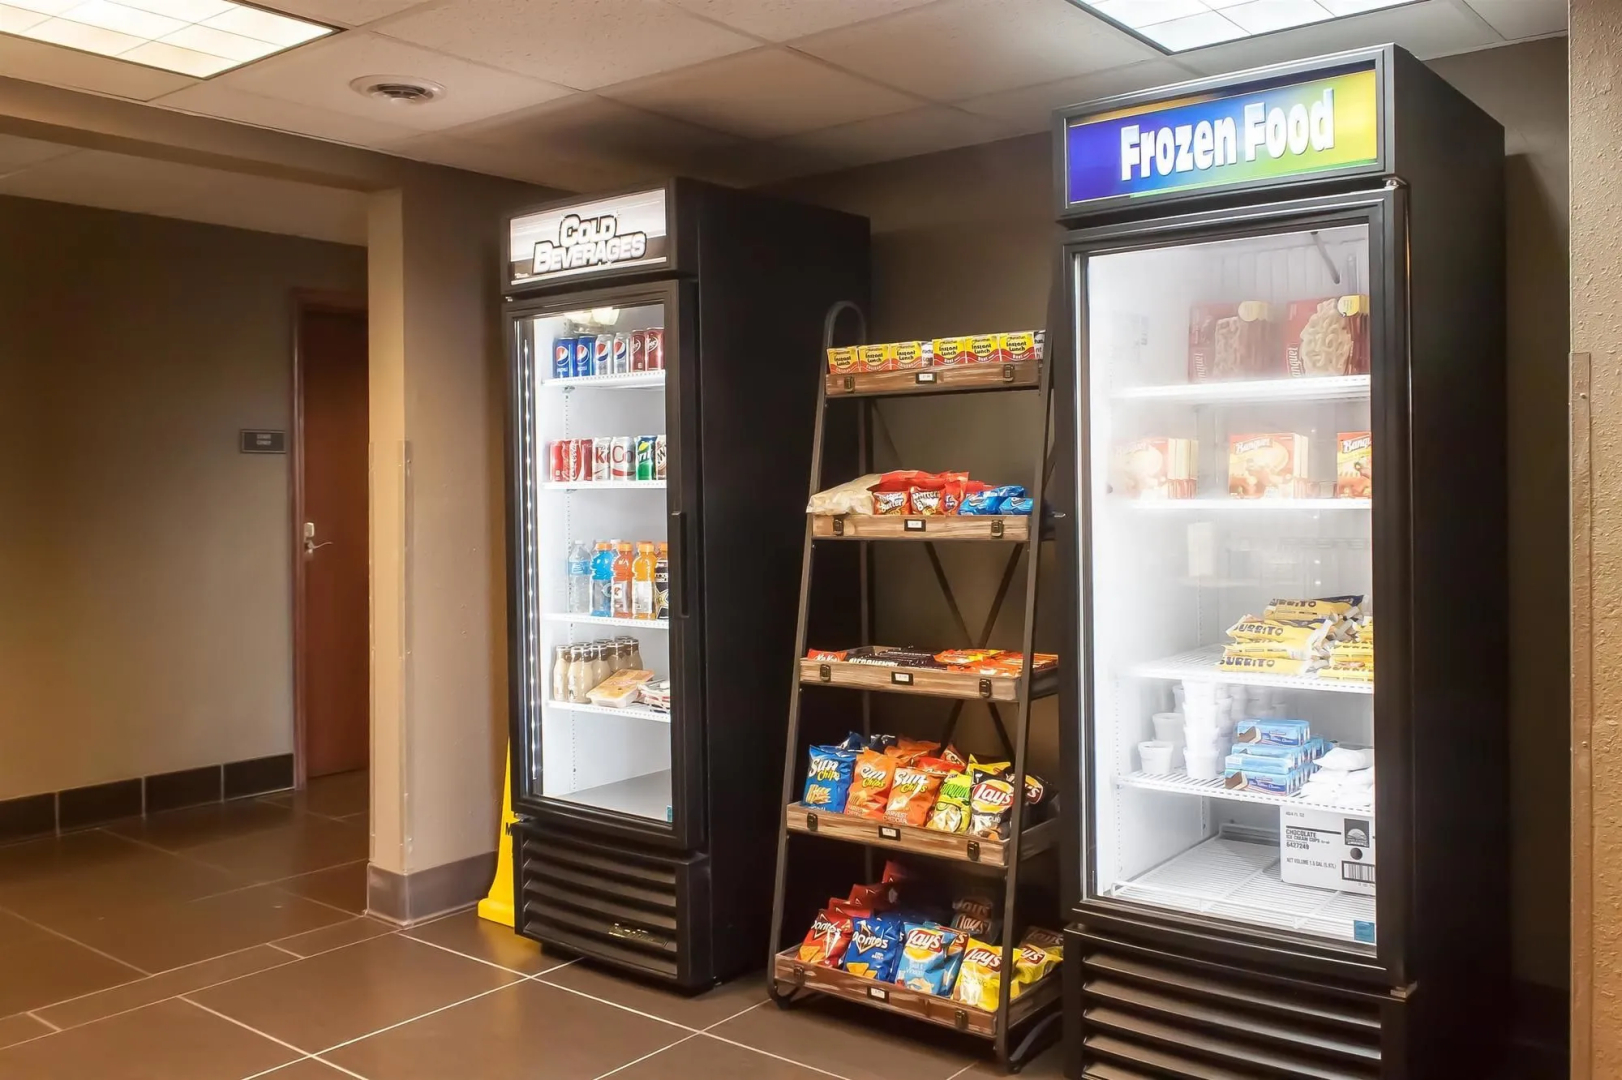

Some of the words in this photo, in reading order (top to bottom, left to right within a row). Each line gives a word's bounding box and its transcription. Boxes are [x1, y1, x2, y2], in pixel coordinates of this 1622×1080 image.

[1120, 116, 1237, 181] Frozen
[1244, 87, 1335, 162] Food
[1287, 346, 1302, 378] anquet
[1286, 829, 1316, 838] CHOCOLATE
